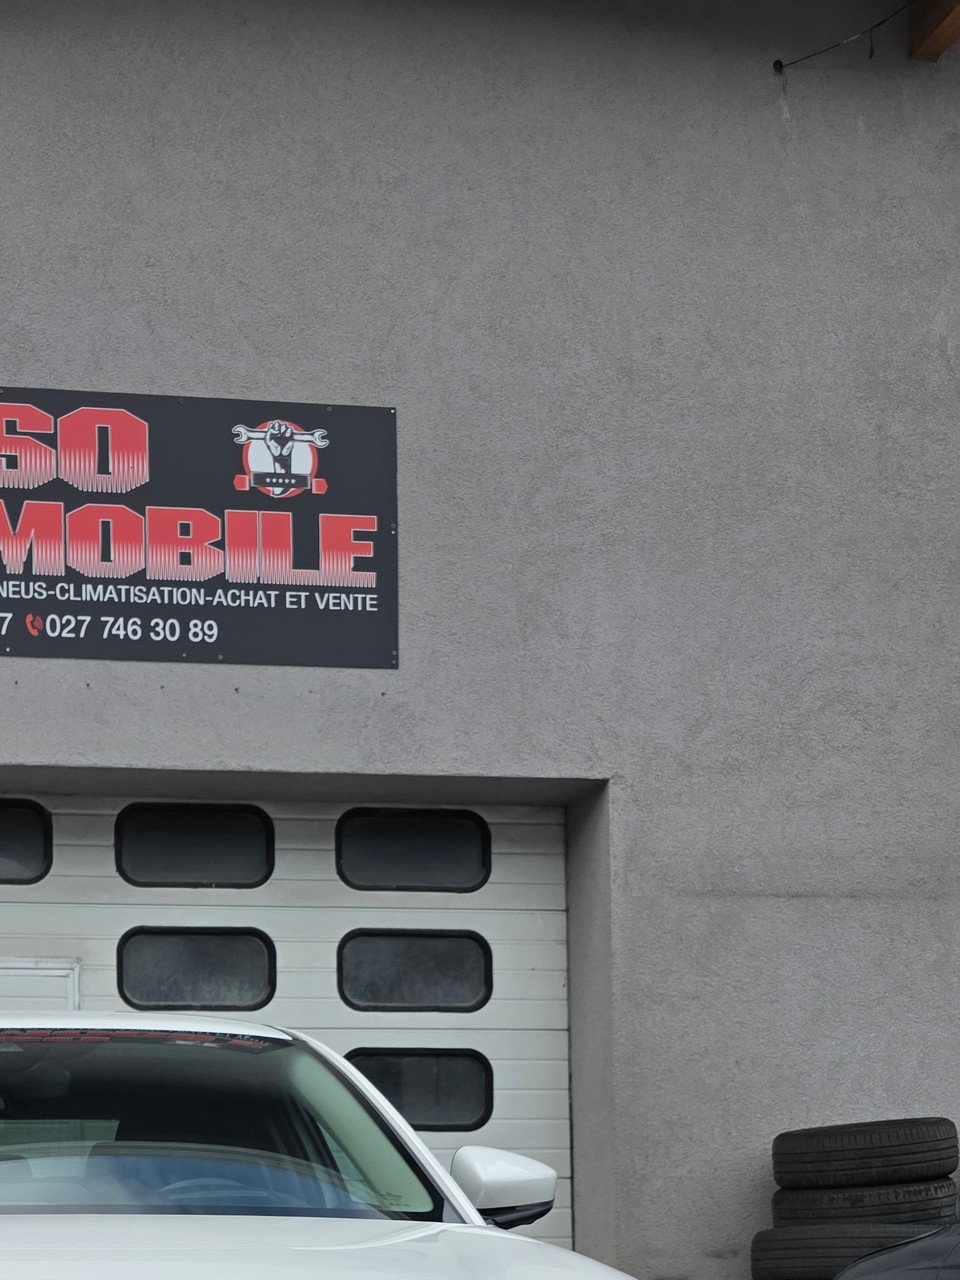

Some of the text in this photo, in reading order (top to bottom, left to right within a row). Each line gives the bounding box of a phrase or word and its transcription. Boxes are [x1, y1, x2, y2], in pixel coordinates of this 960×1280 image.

[286, 591, 309, 609] ET
[315, 592, 379, 611] VENTE
[45, 614, 219, 643] 027 746 30 89
